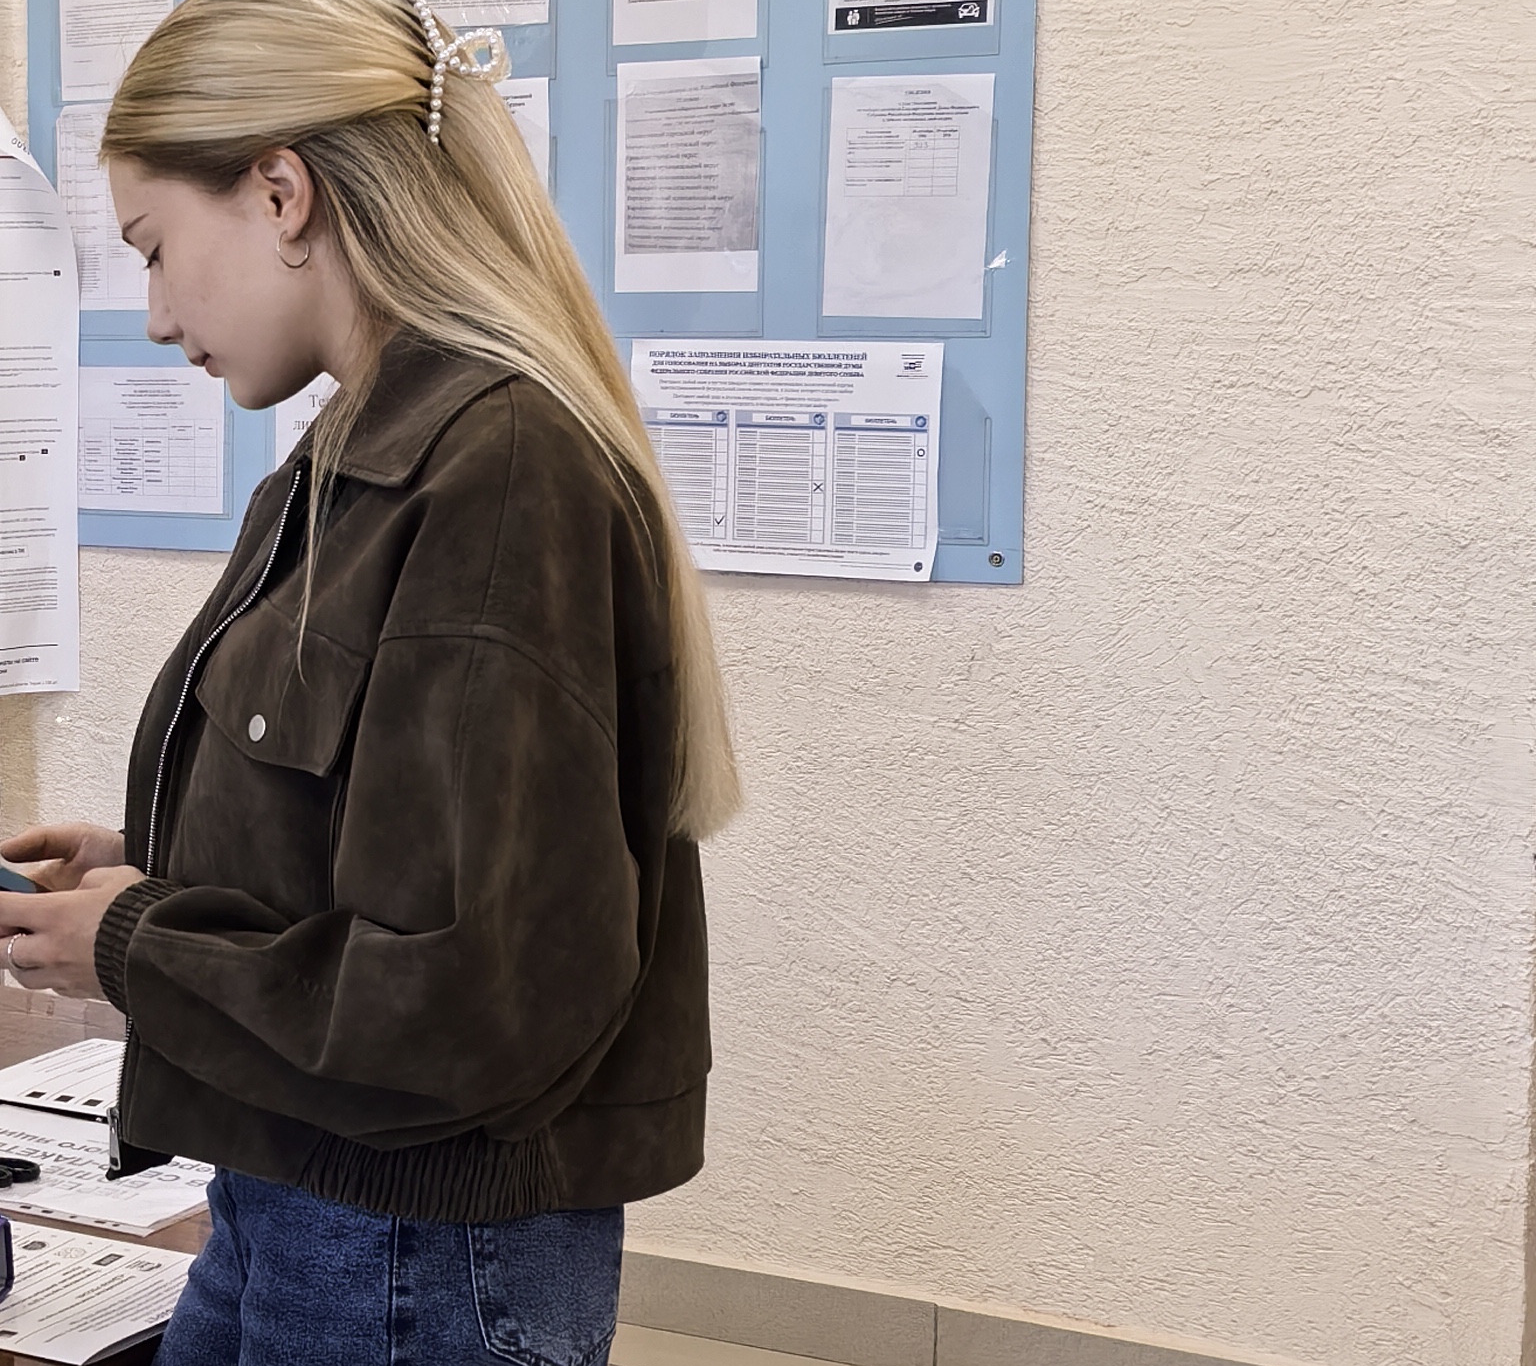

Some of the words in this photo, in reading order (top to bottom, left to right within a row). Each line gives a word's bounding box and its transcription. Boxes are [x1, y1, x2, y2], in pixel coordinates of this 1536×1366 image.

[649, 351, 686, 359] ПОРЯДОК
[688, 351, 742, 359] ЗАПОЛНЕНИЯ
[743, 351, 810, 360] ИЗБИРАТЕЛЬНЫХ
[812, 352, 867, 361] БЮЛЛЕТЕНЕЙ
